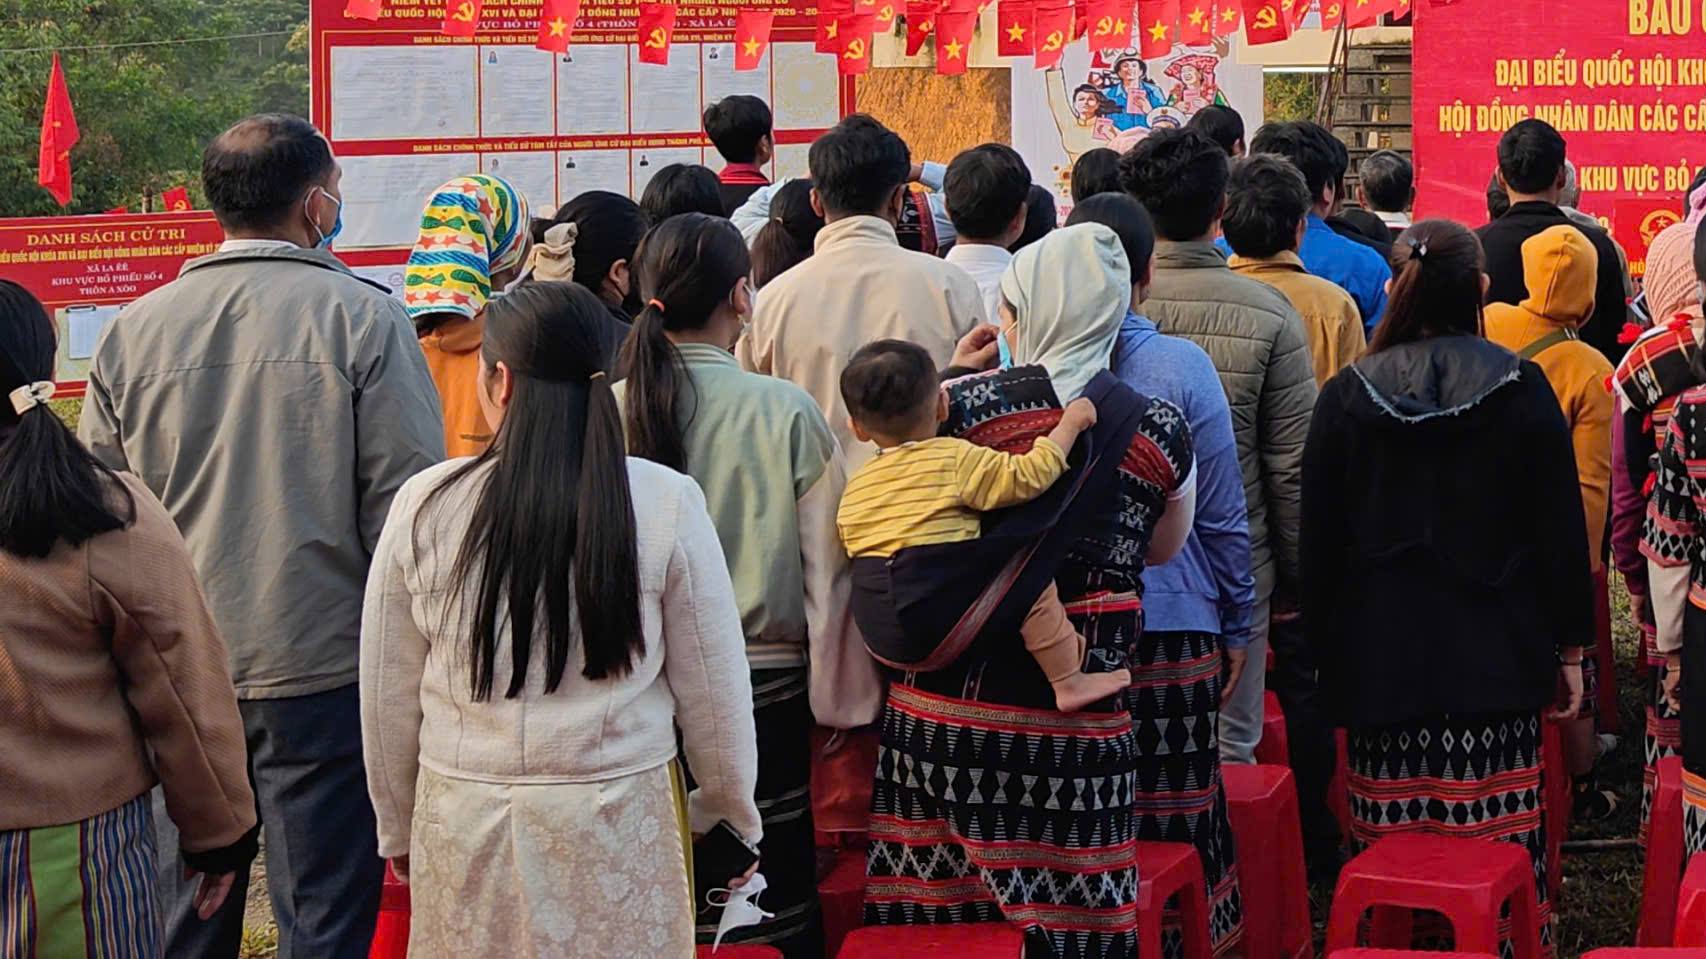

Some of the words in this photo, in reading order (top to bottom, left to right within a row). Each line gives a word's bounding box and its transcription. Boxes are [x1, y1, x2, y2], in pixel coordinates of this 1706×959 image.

[395, 6, 425, 18] QUỐC
[482, 8, 500, 18] XVI
[502, 7, 516, 18] VÀ
[519, 8, 537, 19] ĐẠI
[587, 6, 617, 17] ĐỒNG
[620, 6, 640, 17] NHÂ
[699, 6, 719, 17] CẤP
[721, 7, 738, 17] NHI
[709, 19, 724, 28] LA
[1495, 59, 1528, 91] ĐẠI
[1533, 48, 1577, 86] BIỂU
[1582, 49, 1634, 87] QUỐC
[1639, 53, 1672, 91] HỘI
[1439, 99, 1471, 137] HỘI
[1476, 96, 1530, 132] ĐỒNG
[1534, 99, 1588, 132] NHÂN
[1594, 99, 1634, 132] DÂN
[1639, 98, 1678, 132] CÁC
[1580, 166, 1618, 191] KHU
[1623, 165, 1659, 196] VỰC
[1665, 158, 1689, 192] BỎ
[27, 233, 76, 246] DANH
[80, 229, 126, 244] SÁCH
[130, 226, 155, 241] CỬ
[157, 228, 186, 240] TRI
[87, 263, 100, 273] XÃ
[102, 263, 114, 273] LA
[51, 277, 73, 286] KHU
[75, 275, 95, 286] VỰC
[112, 272, 141, 283] PHIẾU
[143, 270, 157, 281] SỐ
[158, 272, 163, 280] 4
[79, 286, 107, 295] THÔN
